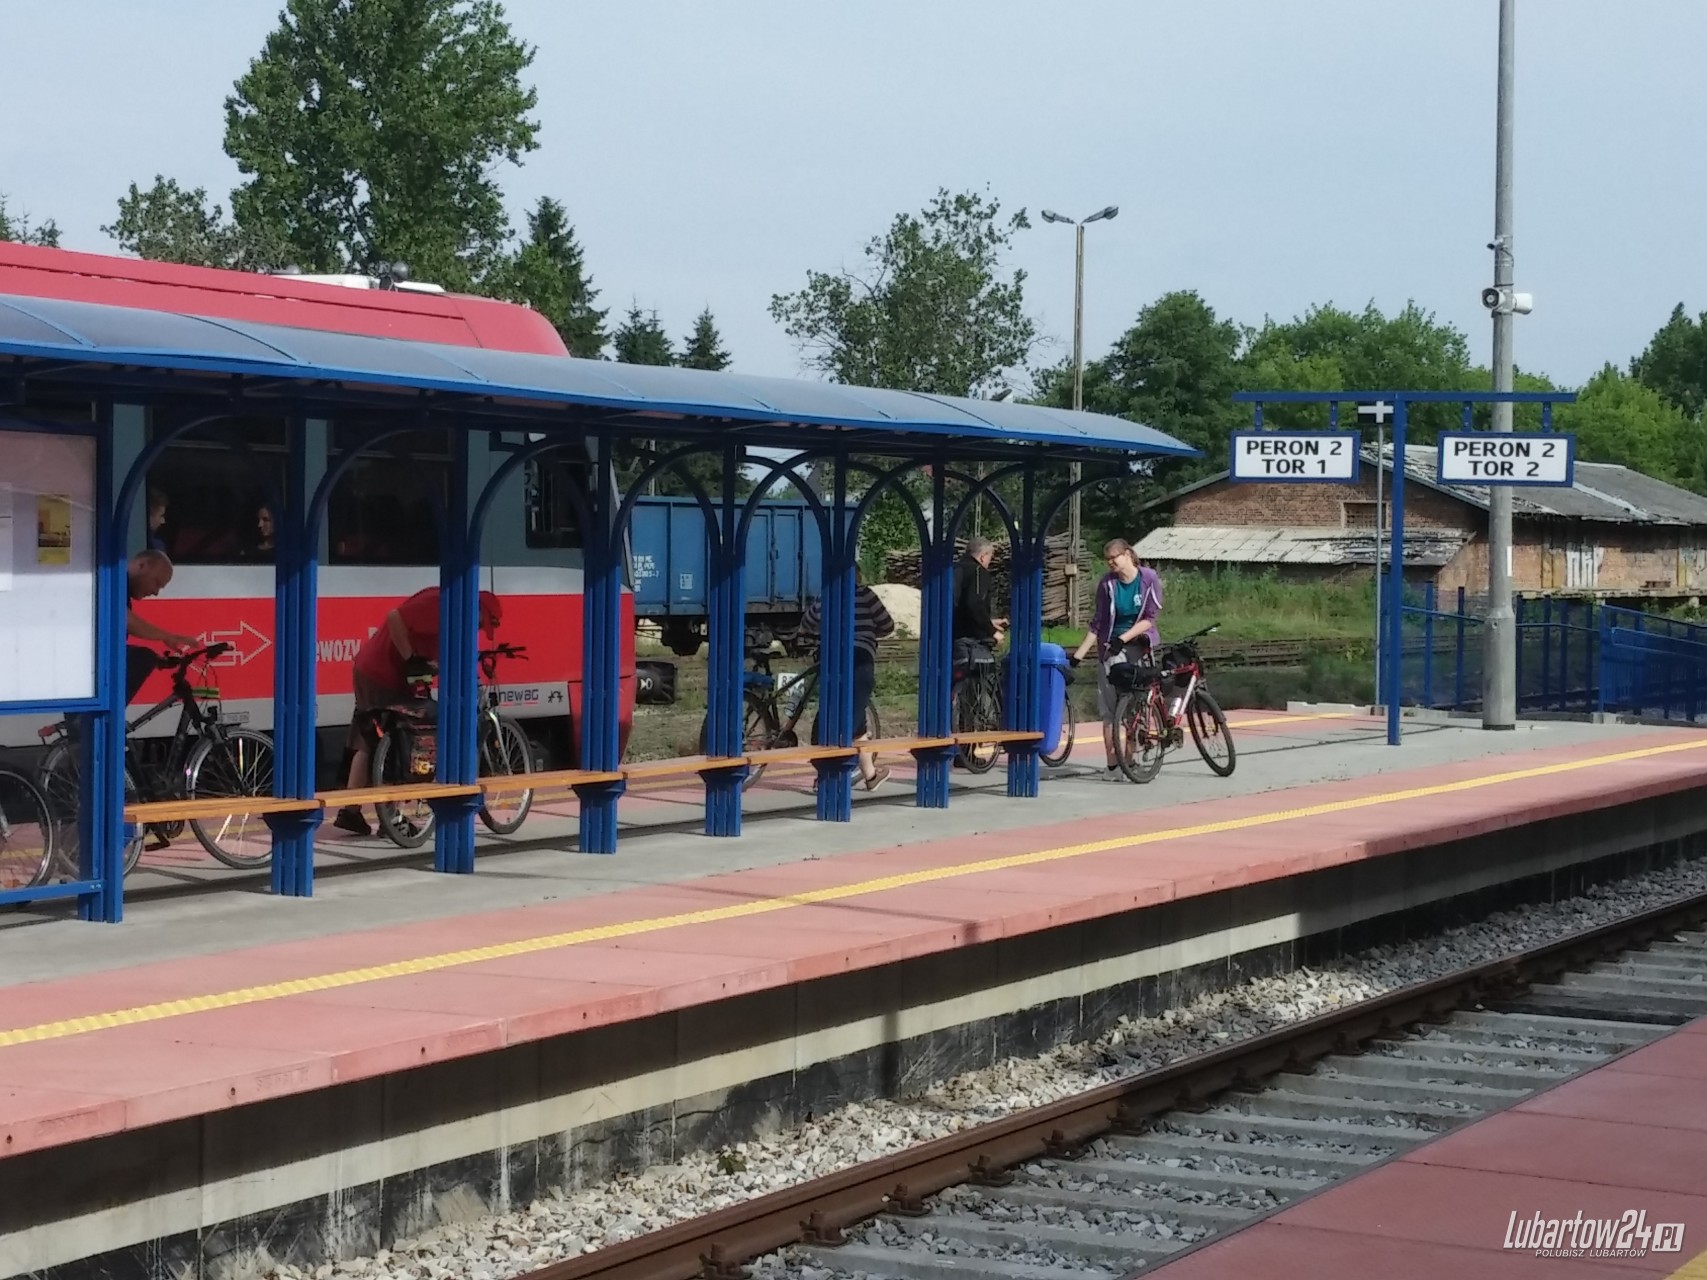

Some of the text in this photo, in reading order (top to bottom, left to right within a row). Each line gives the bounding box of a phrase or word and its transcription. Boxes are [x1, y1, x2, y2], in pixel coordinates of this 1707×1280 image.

[1246, 440, 1342, 456] PERON 2
[1454, 441, 1555, 458] PERON 2
[1261, 458, 1326, 474] TOR 1
[1468, 460, 1539, 477] TOR 2
